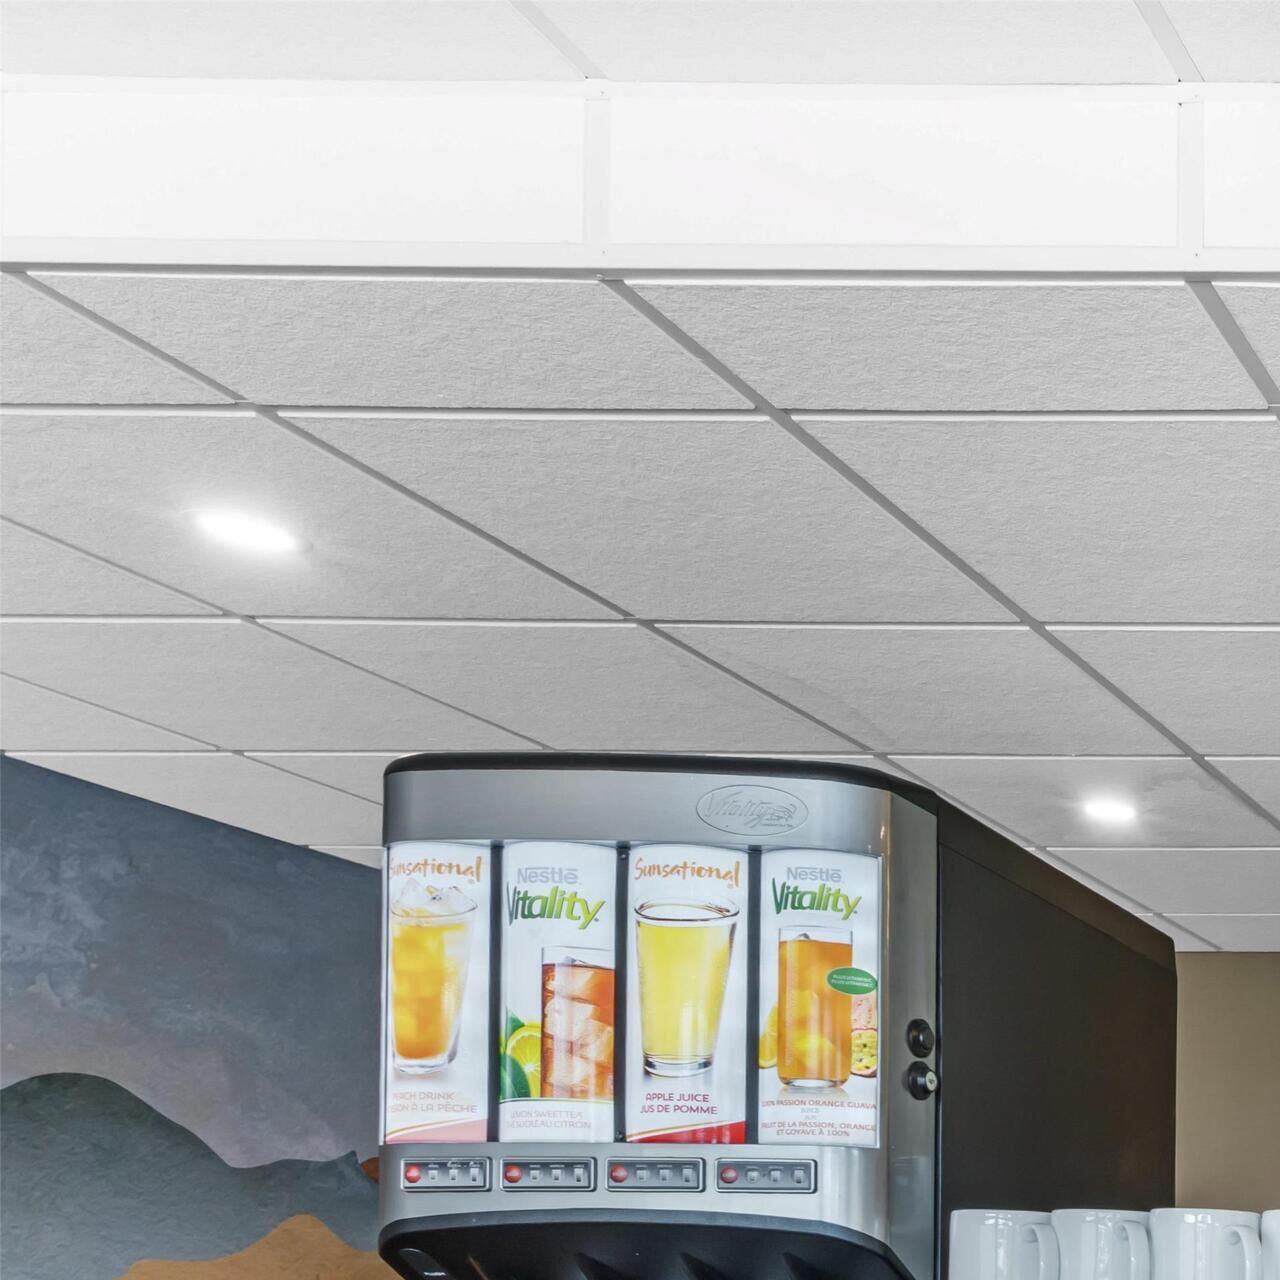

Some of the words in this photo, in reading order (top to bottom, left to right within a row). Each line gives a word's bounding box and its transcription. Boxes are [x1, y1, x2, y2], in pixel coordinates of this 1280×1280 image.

[634, 857, 741, 888] Sunsational
[771, 876, 862, 921] Vitality
[506, 882, 606, 930] Vitality
[419, 1091, 455, 1100] DRINK
[645, 1092, 675, 1101] APPLE
[676, 1093, 710, 1103] JUICE
[420, 1103, 433, 1112] LA
[438, 1102, 480, 1113] PÊCHE
[808, 1099, 845, 1107] ORANGE
[640, 1104, 655, 1114] JUS
[657, 1104, 670, 1113] DE
[673, 1105, 718, 1115] POMME
[554, 1120, 592, 1129] CITRON
